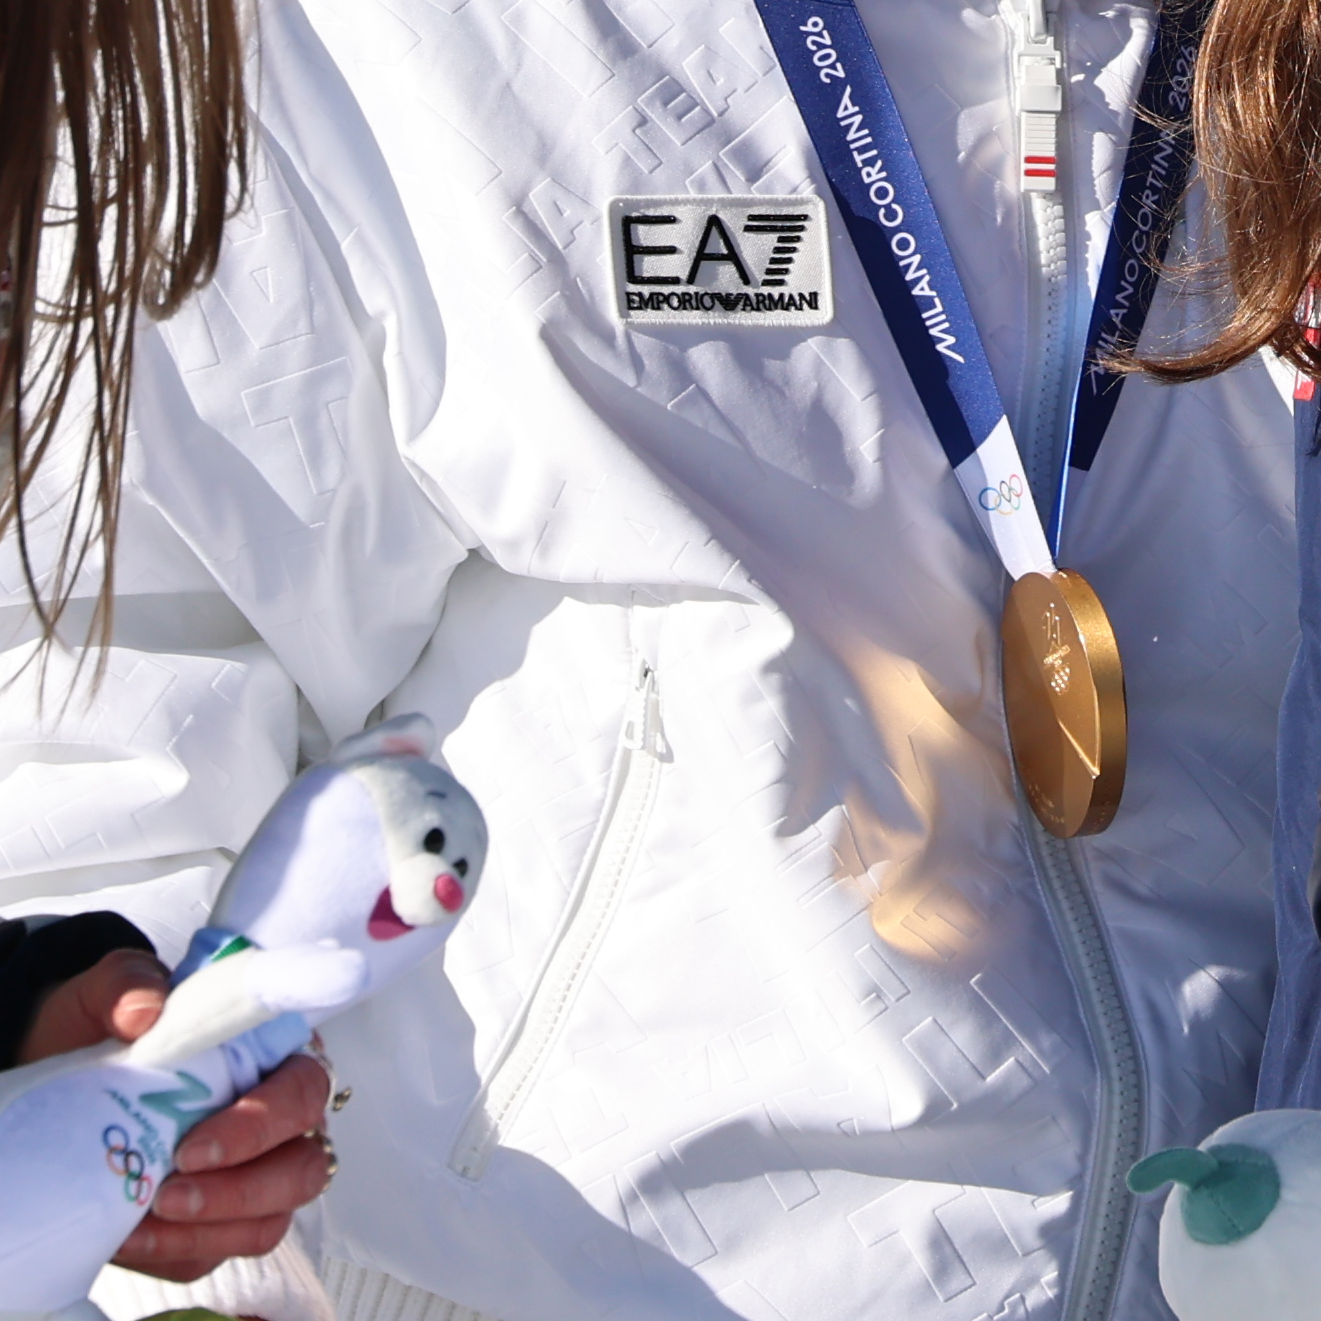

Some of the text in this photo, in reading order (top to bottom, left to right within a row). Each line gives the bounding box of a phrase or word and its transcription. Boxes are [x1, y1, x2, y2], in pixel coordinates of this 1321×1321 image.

[799, 16, 965, 364] MILANO CORTINA 2026
[621, 214, 810, 287] EA7
[624, 291, 820, 312] EMPORIO ARMANI
